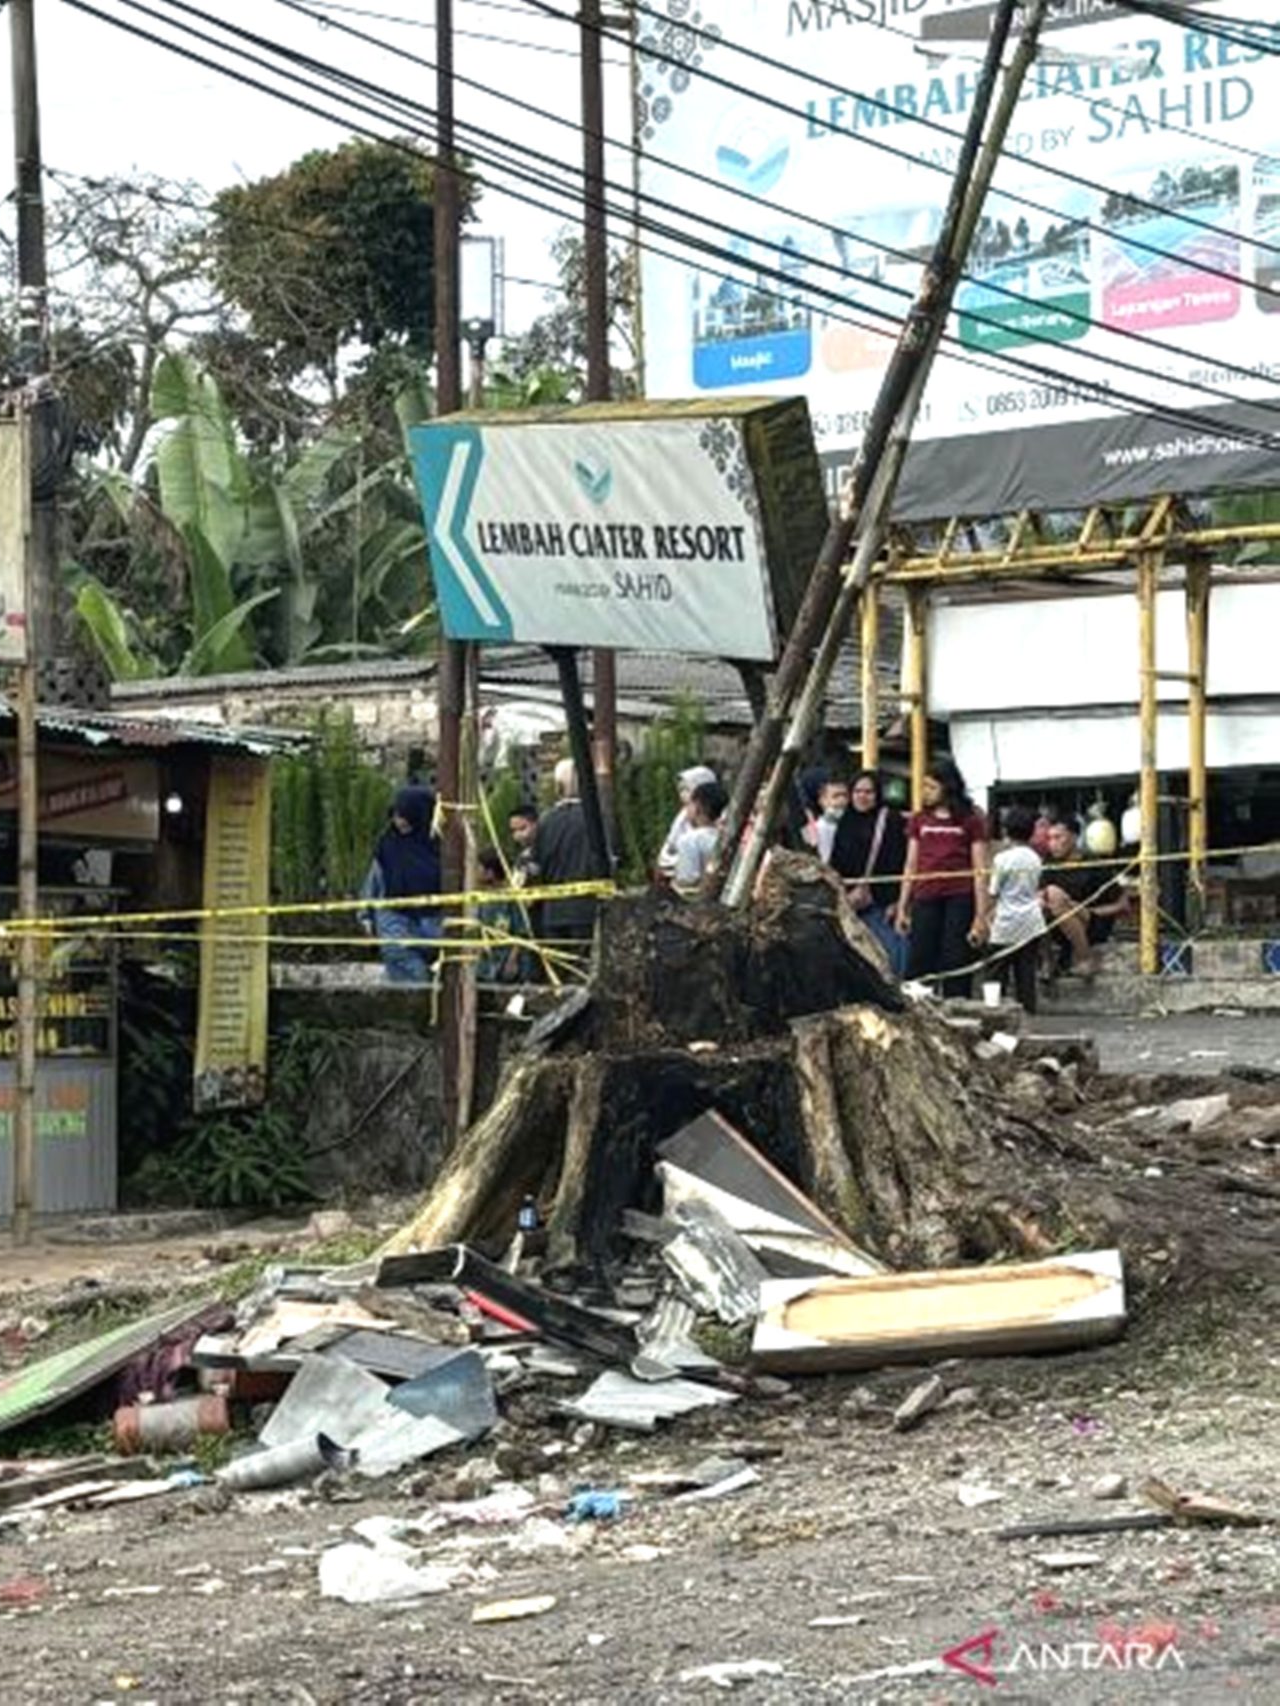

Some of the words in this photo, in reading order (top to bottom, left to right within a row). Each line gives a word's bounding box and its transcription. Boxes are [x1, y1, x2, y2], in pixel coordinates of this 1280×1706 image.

[805, 70, 984, 139] LEMBAH
[1087, 75, 1254, 144] SAHID
[477, 520, 565, 558] LEMBAH
[569, 522, 648, 560] CIATER
[653, 524, 746, 562] RESORT
[613, 570, 674, 602] SAHID
